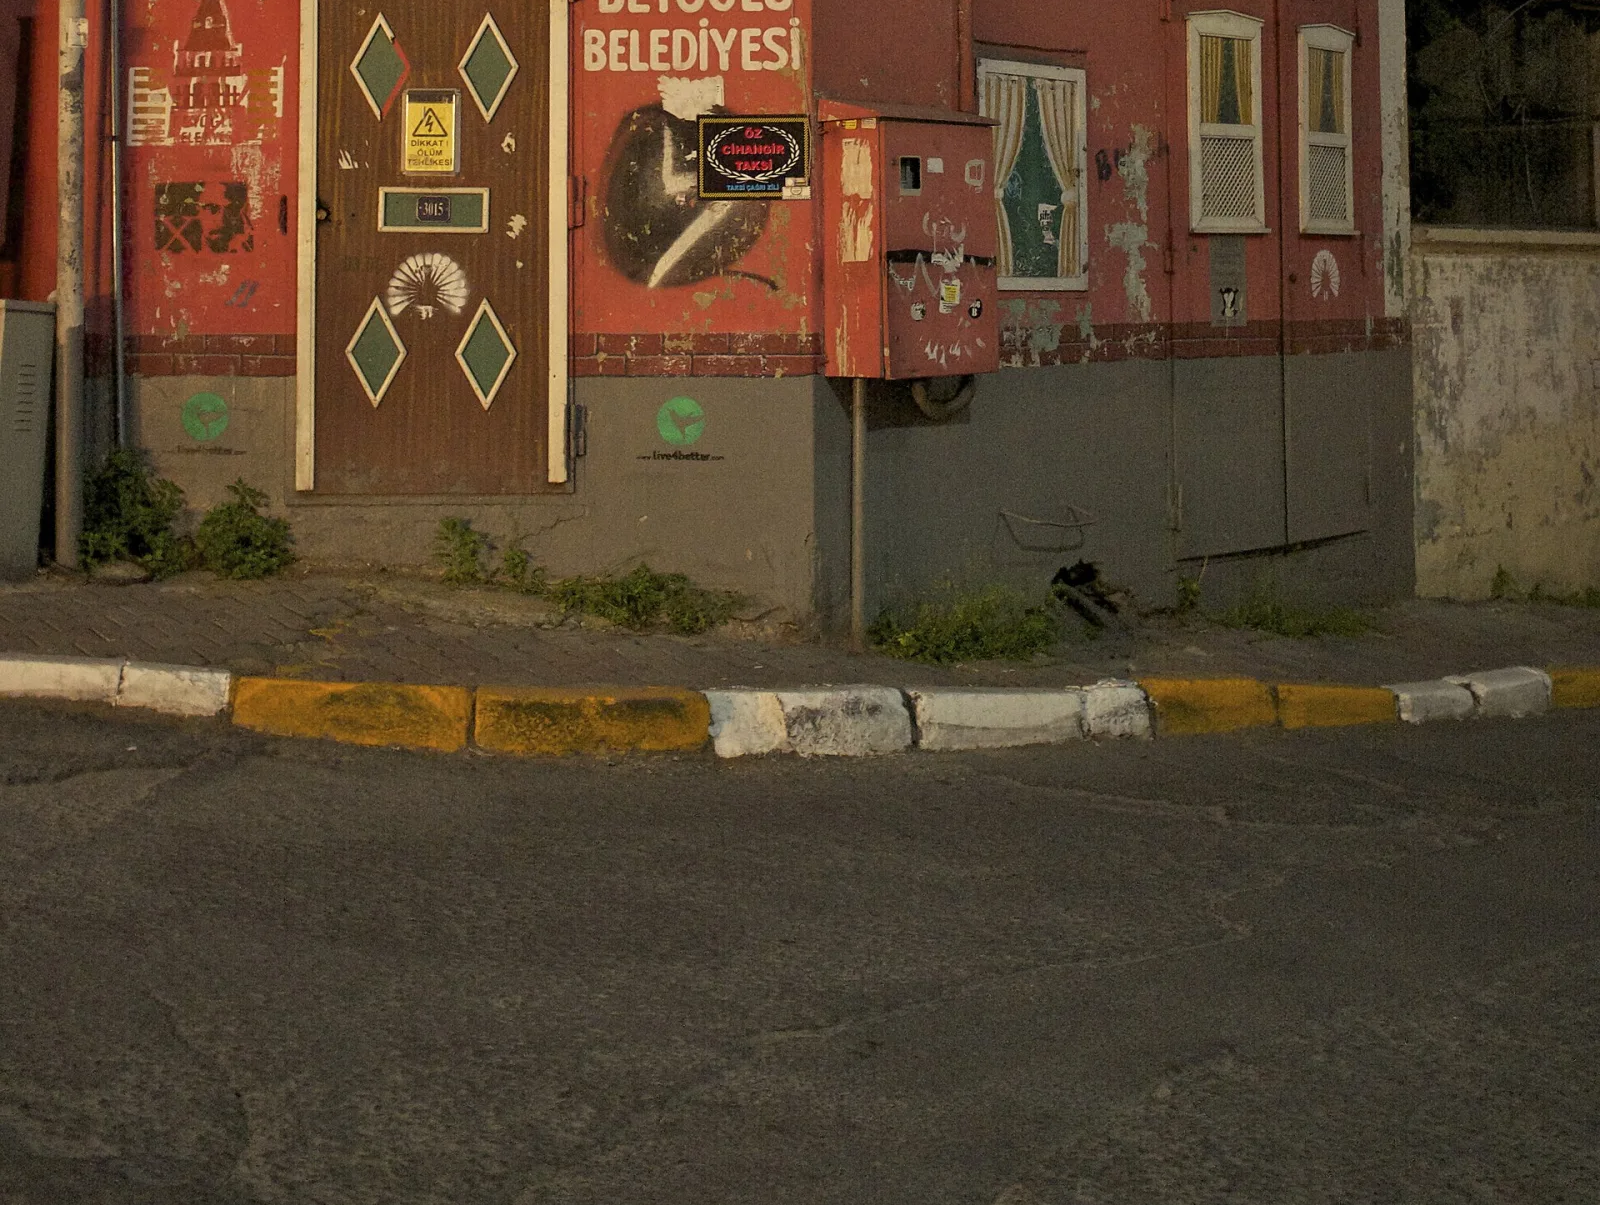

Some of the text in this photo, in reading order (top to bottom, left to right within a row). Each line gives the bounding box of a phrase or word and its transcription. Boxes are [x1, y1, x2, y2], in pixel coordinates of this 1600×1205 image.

[583, 17, 801, 71] BELEDİYESİ
[744, 127, 763, 139] ÖZ
[410, 139, 444, 147] DİKKAT
[721, 143, 785, 155] CİHANGİR
[416, 148, 443, 156] ÖLÜM
[407, 157, 453, 166] TEHLİKESİ
[734, 159, 773, 171] TAKSİ
[422, 202, 444, 216] 3015
